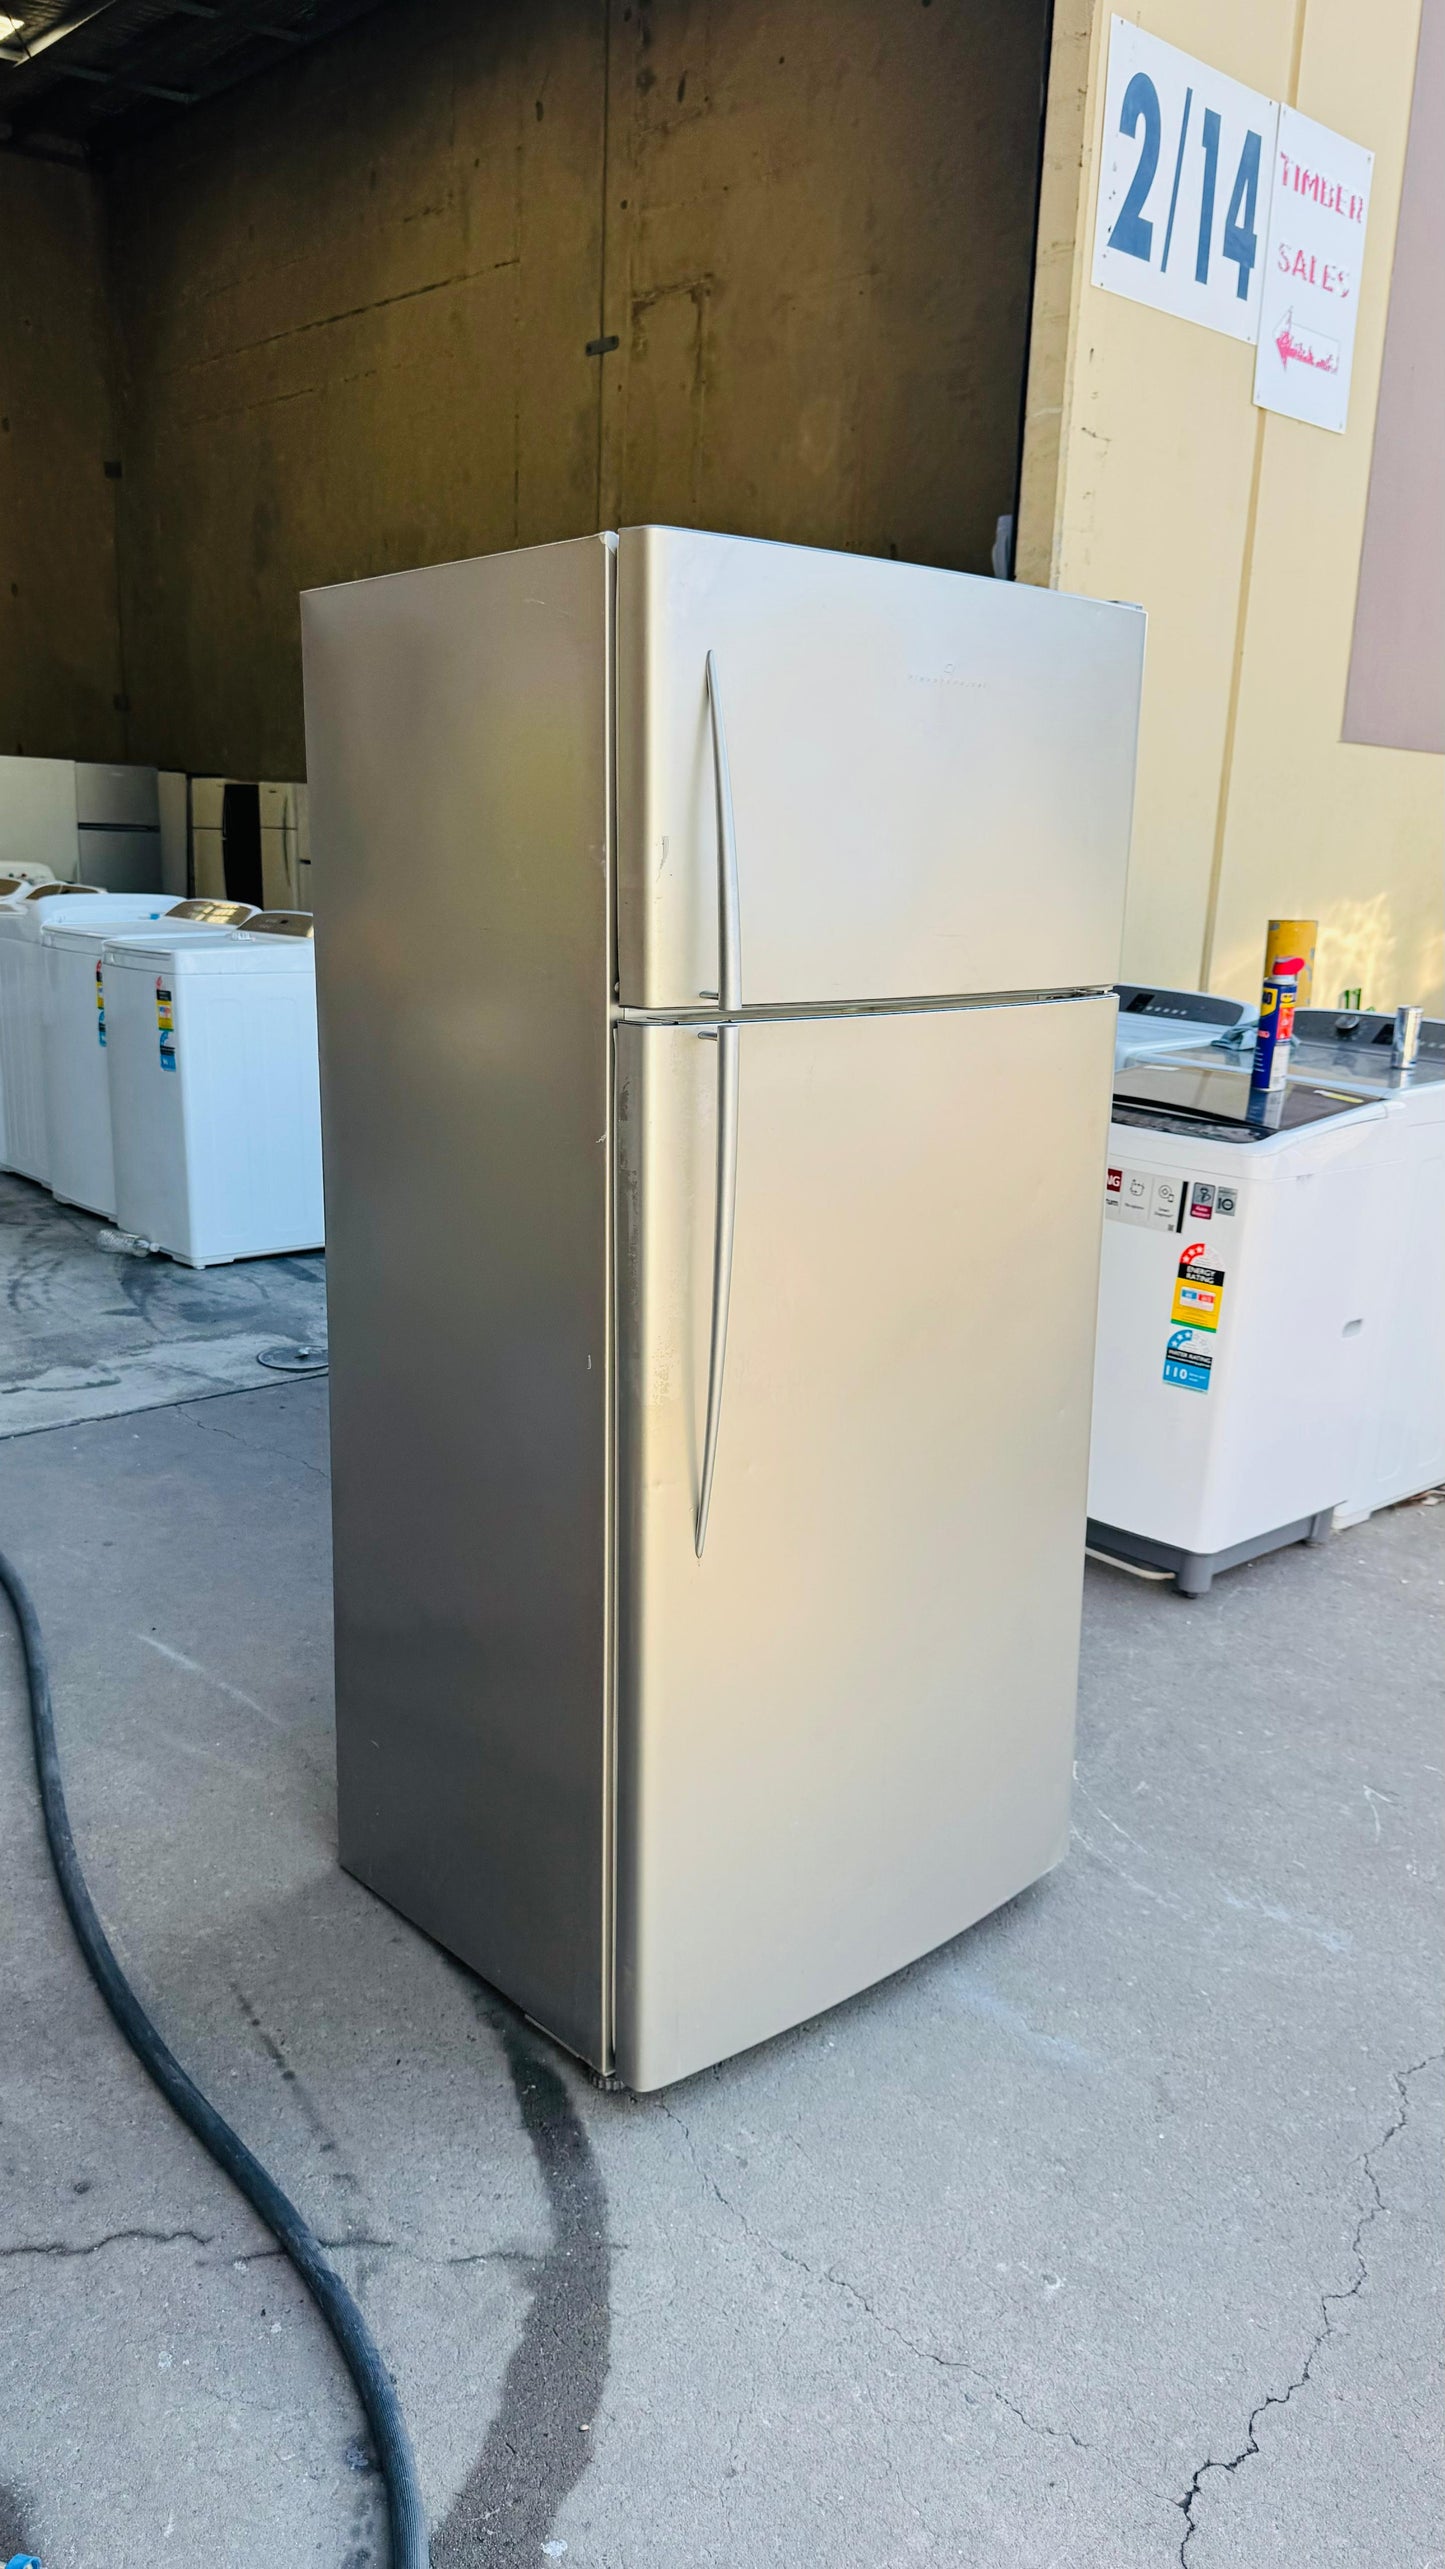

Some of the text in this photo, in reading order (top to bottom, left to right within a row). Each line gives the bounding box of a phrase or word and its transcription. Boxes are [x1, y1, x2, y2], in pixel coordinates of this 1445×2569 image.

[1107, 72, 1262, 301] 2/14
[1280, 151, 1363, 224] TIMBER
[1278, 242, 1350, 298] SALES
[1185, 1273, 1215, 1284] RATING
[1186, 1265, 1216, 1277] ENERGY
